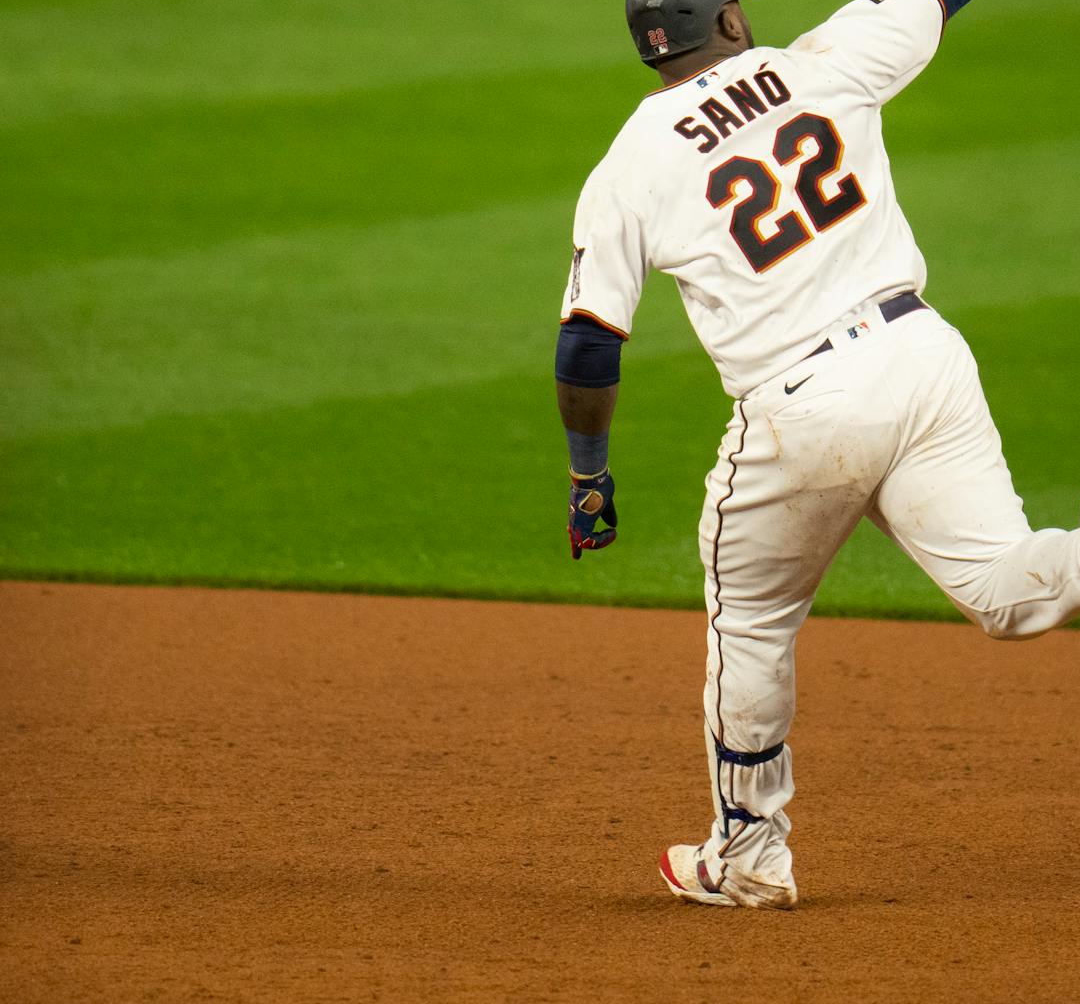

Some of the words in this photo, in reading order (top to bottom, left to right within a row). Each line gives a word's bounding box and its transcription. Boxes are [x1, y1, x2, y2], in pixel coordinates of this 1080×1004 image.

[647, 27, 668, 46] 22
[673, 61, 792, 154] SANÓ
[705, 112, 868, 275] 22
